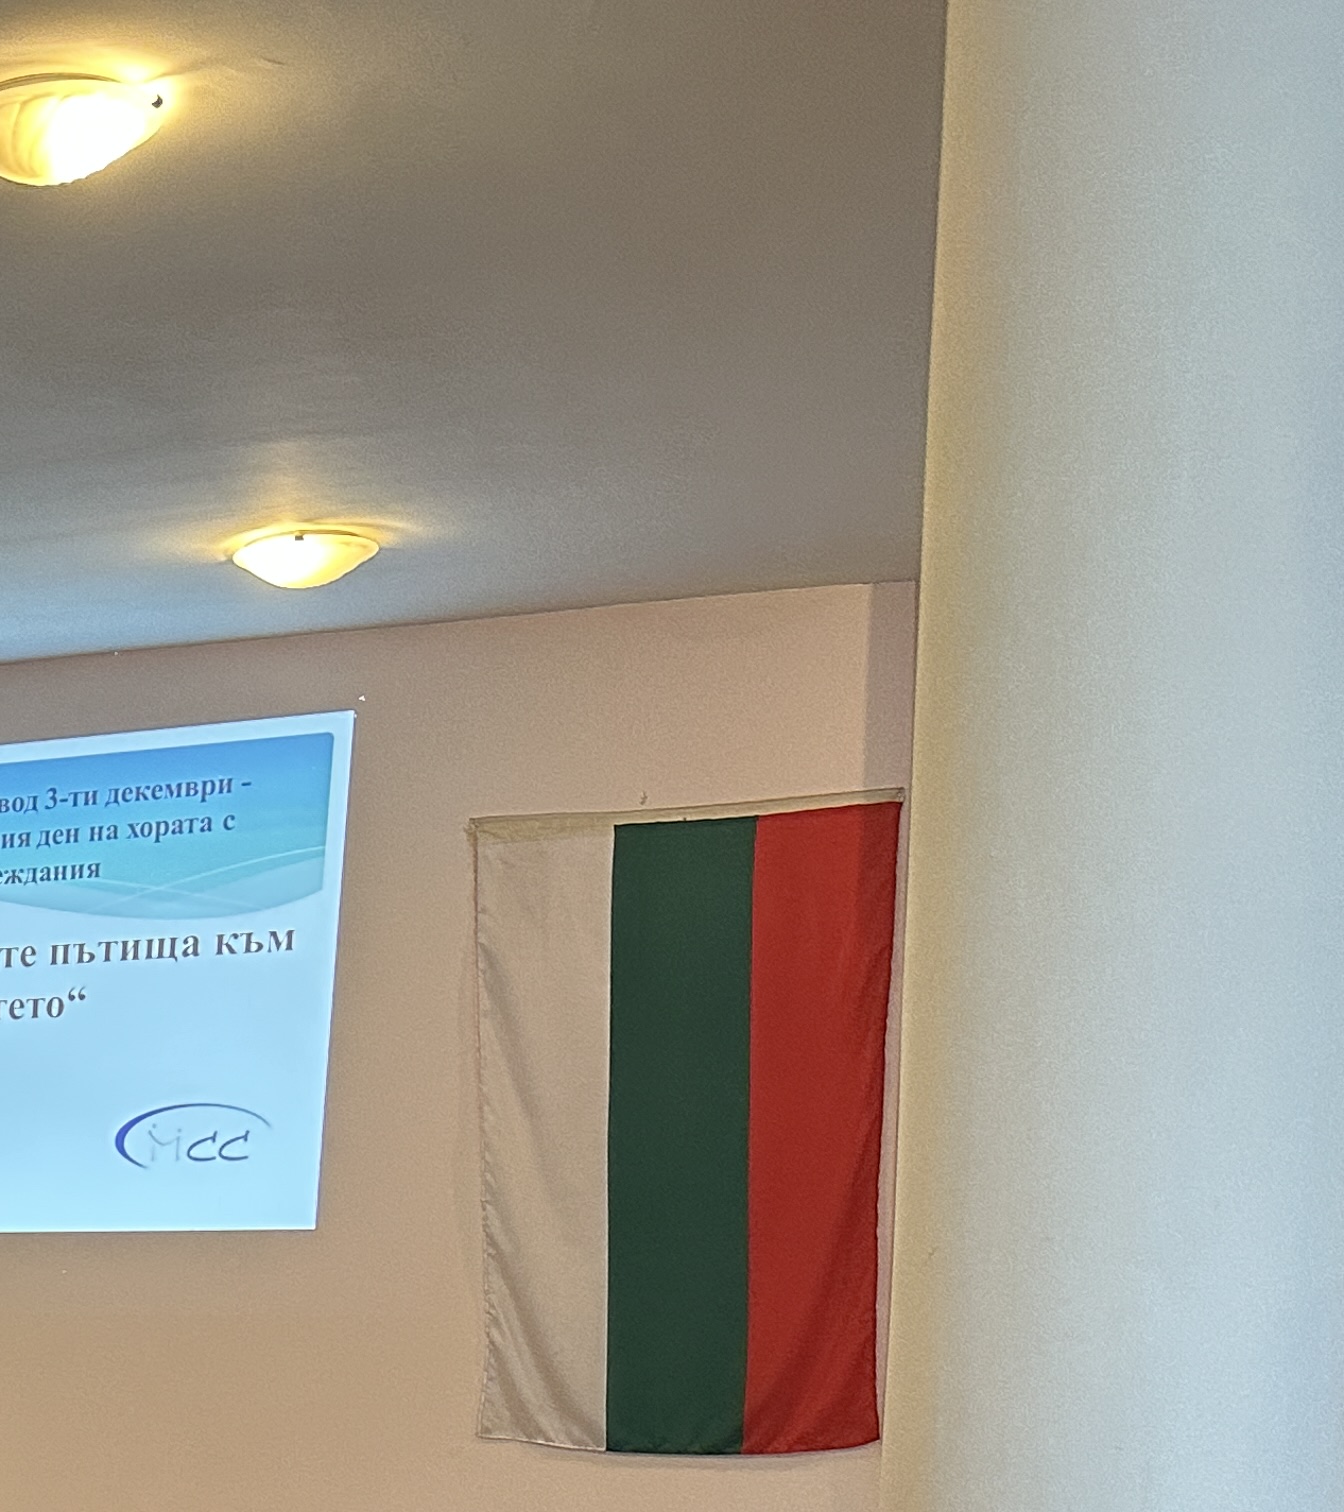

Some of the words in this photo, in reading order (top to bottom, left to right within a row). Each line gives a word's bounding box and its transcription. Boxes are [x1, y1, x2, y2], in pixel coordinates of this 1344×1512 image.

[44, 787, 98, 810] 3-ти
[105, 777, 233, 807] декември
[36, 828, 79, 849] ден
[88, 824, 119, 842] на
[126, 816, 212, 843] хората
[223, 814, 236, 831] с
[49, 933, 200, 966] пътища
[215, 929, 296, 956] към
